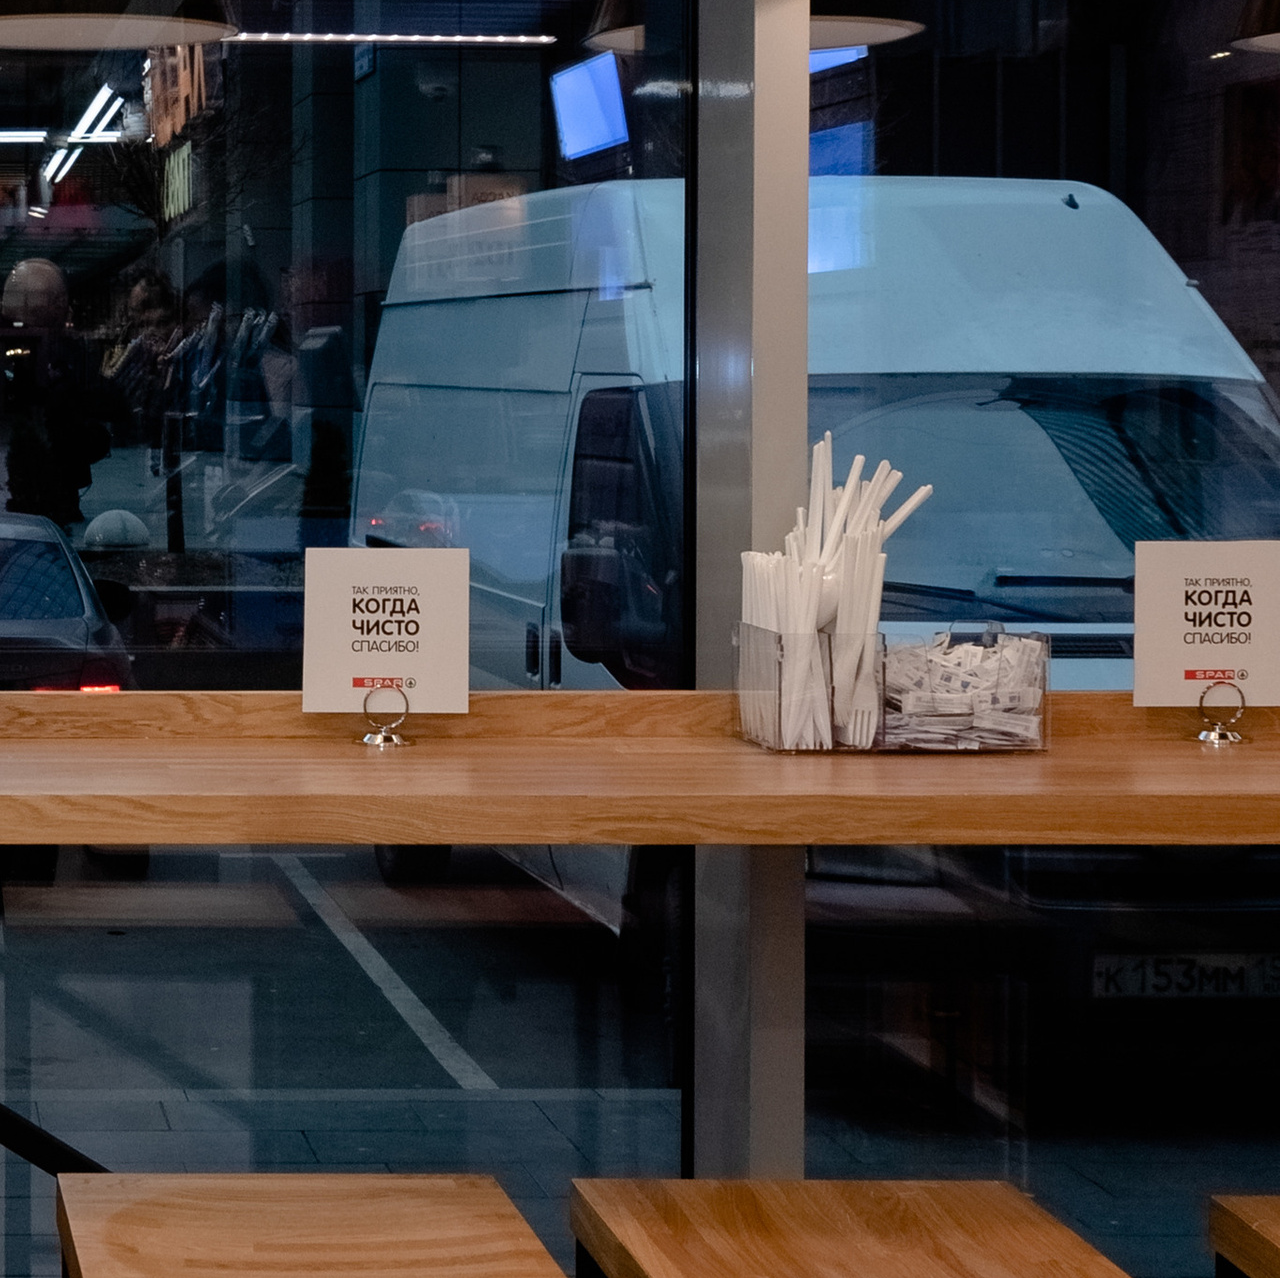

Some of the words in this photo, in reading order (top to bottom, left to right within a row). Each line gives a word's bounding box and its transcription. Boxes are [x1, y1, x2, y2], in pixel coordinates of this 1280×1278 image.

[1184, 578, 1201, 587] ТАК
[1204, 578, 1253, 588] ПРИЯТНО,
[352, 586, 369, 595] ТАК
[372, 586, 420, 596] ПРИЯТНО,
[1184, 590, 1253, 609] КОГДА
[352, 597, 420, 617] КОГДА
[1184, 611, 1252, 628] ЧИСТО
[352, 619, 420, 636] ЧИСТО
[1184, 632, 1251, 645] СПАСИБО!
[352, 640, 420, 652] СПАСИБО!
[1195, 670, 1235, 679] SPAR
[364, 678, 403, 688] SPAR
